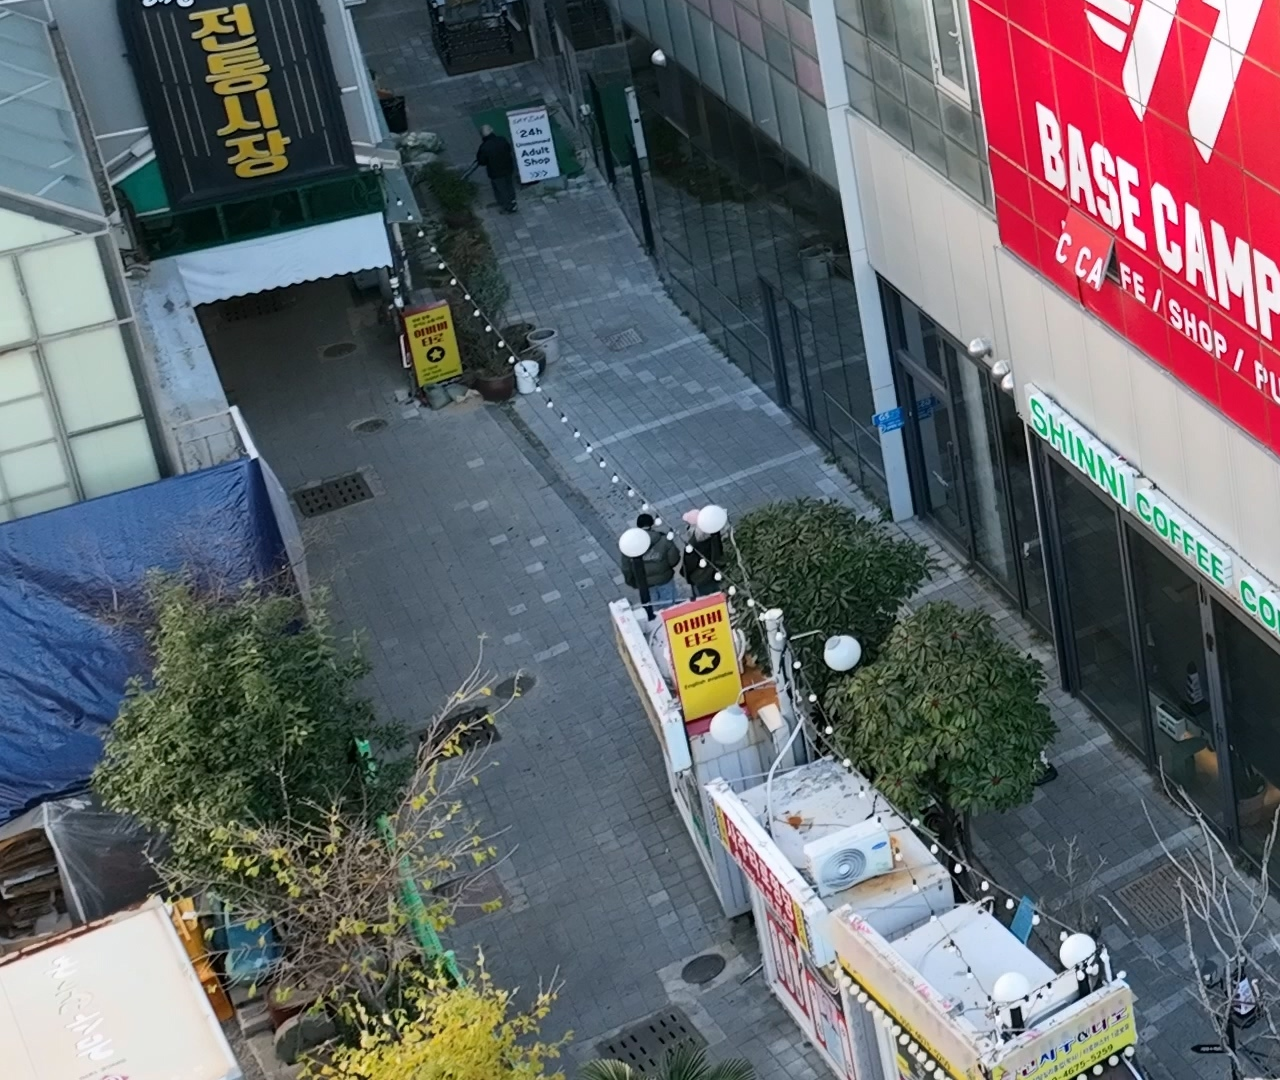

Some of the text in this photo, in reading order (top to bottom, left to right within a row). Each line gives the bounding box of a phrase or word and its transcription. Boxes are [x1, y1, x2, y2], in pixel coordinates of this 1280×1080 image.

[188, 3, 292, 179] 전통시장
[521, 146, 550, 158] Adult
[523, 157, 551, 167] Shop
[1035, 101, 1148, 253] BASE
[1168, 298, 1229, 362] SHOP
[1028, 396, 1134, 510] SHINNI
[1135, 490, 1232, 588] COFFEE
[684, 628, 718, 649] 타로
[684, 670, 734, 691] English available
